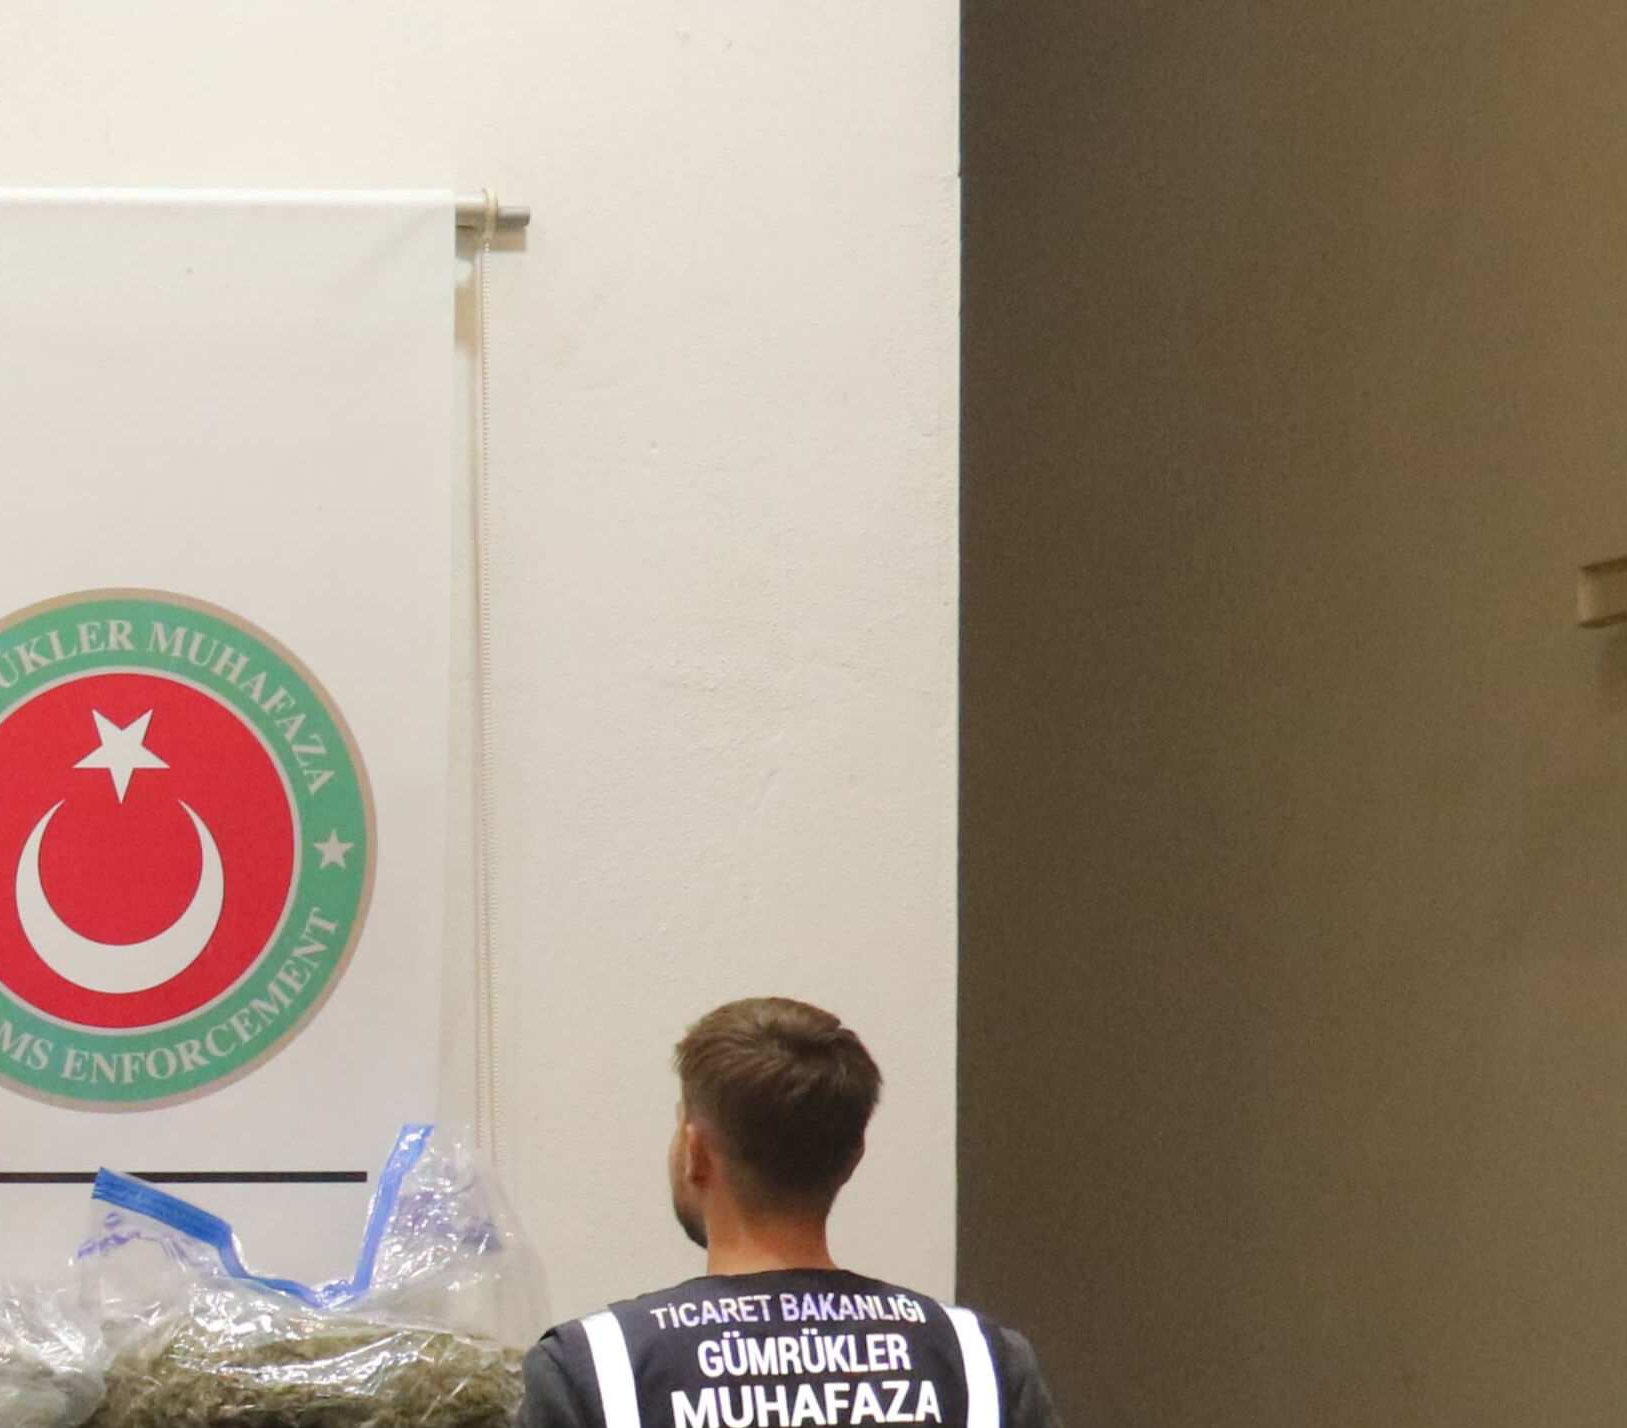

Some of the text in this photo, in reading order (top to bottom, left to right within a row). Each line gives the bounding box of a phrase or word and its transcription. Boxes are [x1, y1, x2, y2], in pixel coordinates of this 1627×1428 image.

[146, 620, 336, 796] MUHAFAZA
[60, 907, 340, 1085] ENFORCEMENT
[650, 1292, 927, 1331] TİCARET BAKANLIĞI
[697, 1328, 912, 1379] GÜMRÜKLER
